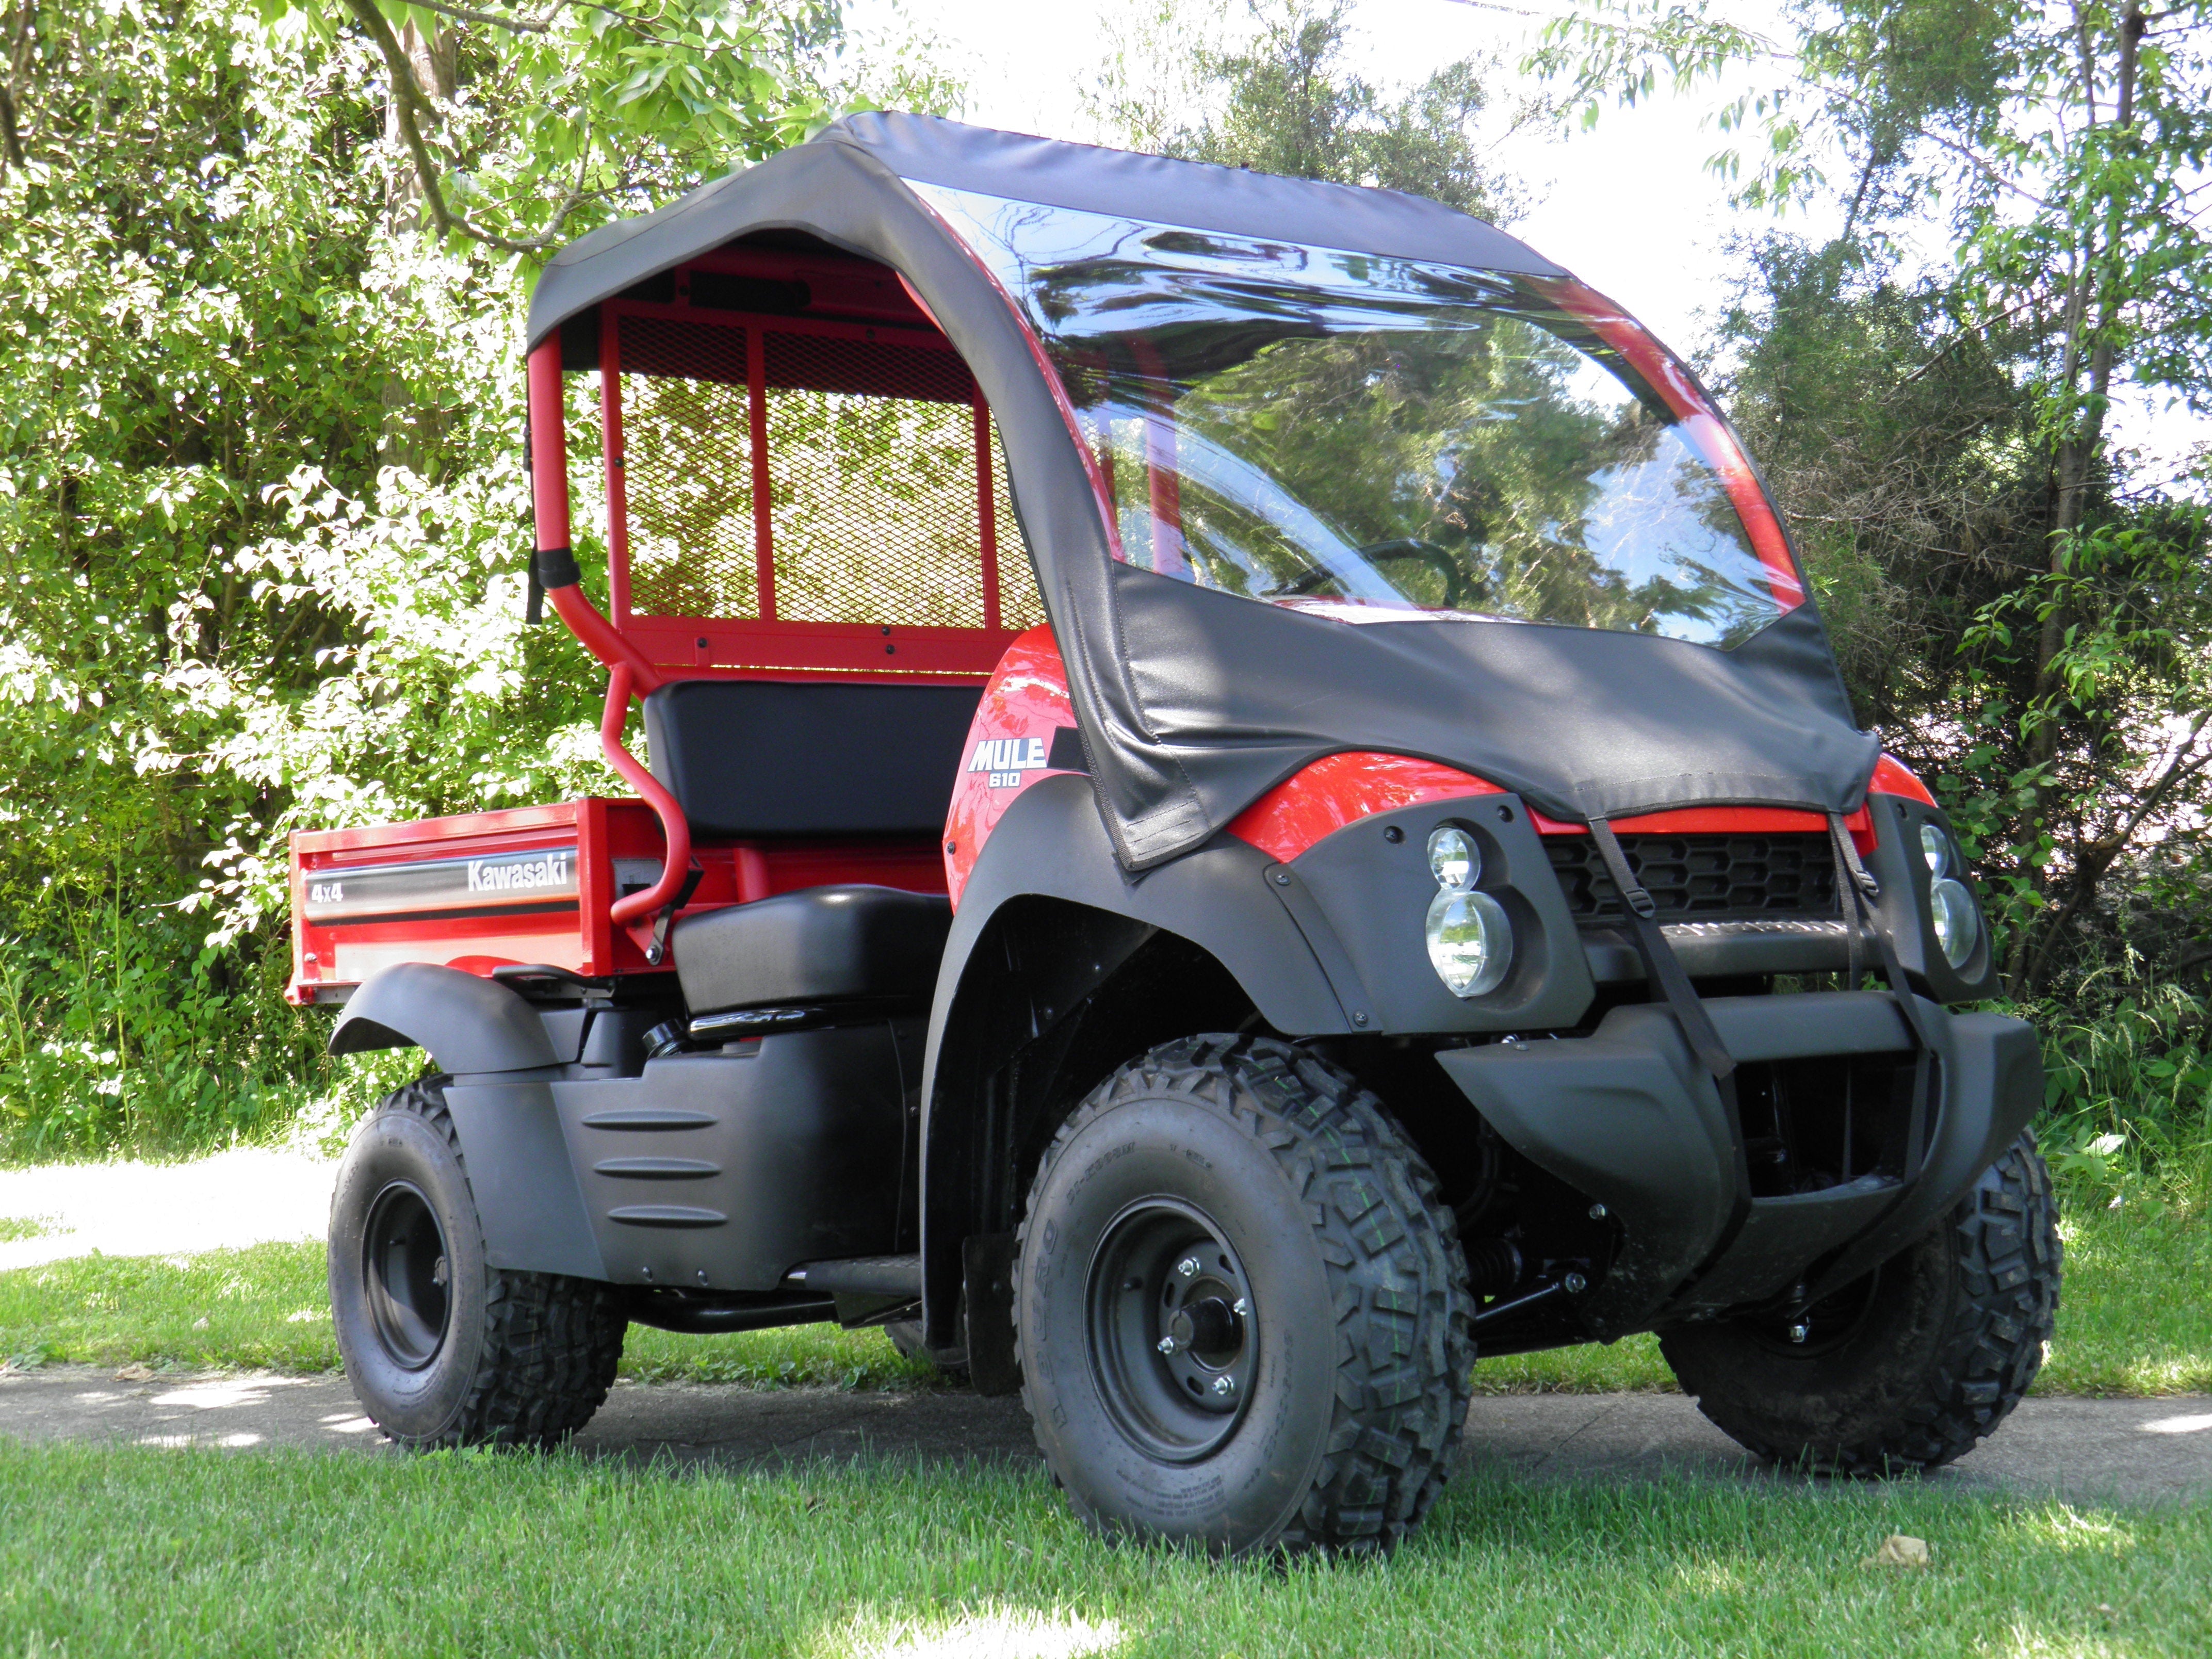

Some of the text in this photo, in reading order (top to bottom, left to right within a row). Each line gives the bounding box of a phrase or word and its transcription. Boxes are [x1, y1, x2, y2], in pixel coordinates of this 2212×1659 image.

[968, 738, 1047, 772] MULE
[989, 773, 1021, 787] 610
[468, 853, 567, 891] Kawasaki
[311, 883, 343, 903] 4x4
